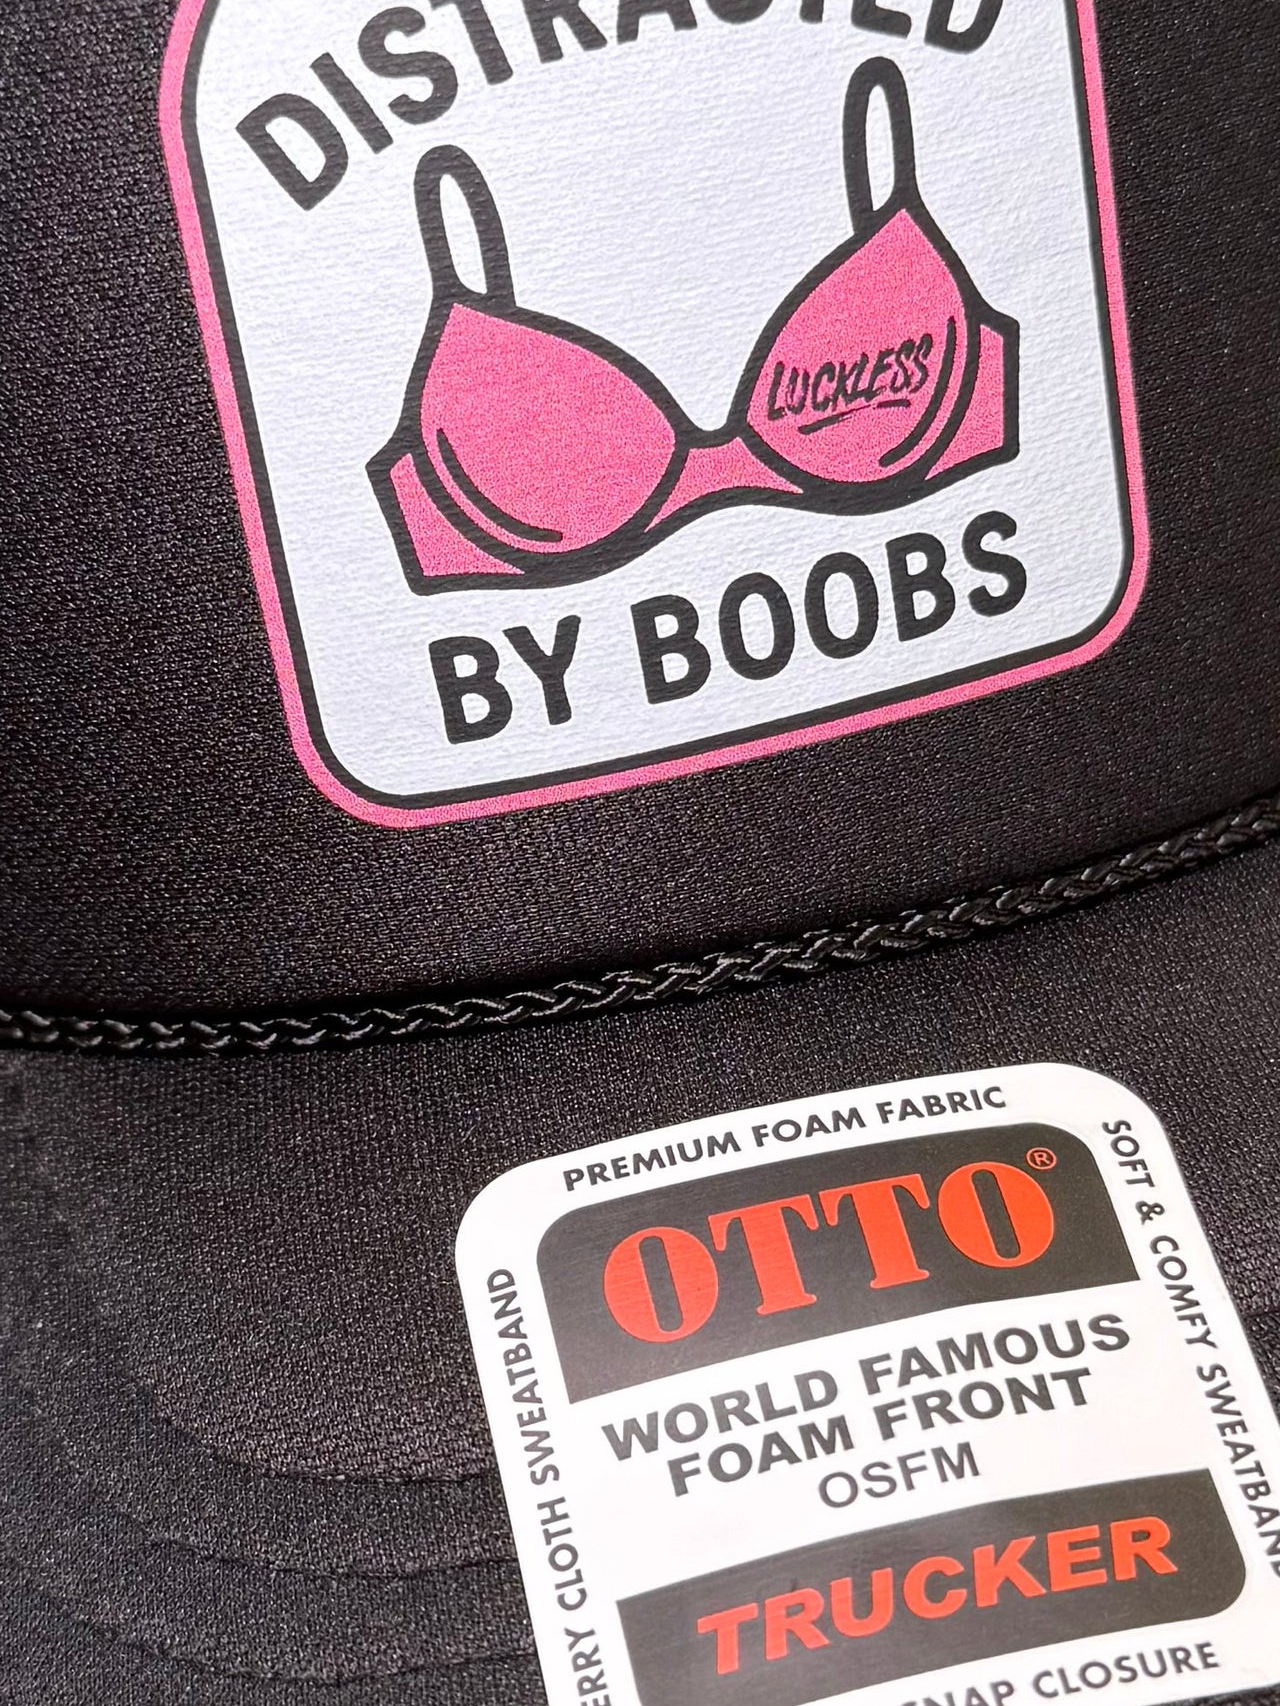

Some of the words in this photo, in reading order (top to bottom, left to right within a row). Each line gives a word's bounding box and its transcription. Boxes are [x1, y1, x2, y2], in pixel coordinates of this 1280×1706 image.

[766, 332, 934, 420] LUCKLESS
[428, 614, 581, 745] BY
[631, 509, 1028, 705] BOOBS
[562, 1131, 742, 1193] PREMIUM
[754, 1106, 867, 1149] FOAM
[875, 1085, 1008, 1126] FABRIC
[1101, 1118, 1155, 1191] SOFT
[1138, 1200, 1163, 1226] &
[1148, 1235, 1217, 1352] COMFY
[486, 1268, 563, 1484] SWEATBAND
[601, 1368, 839, 1463] WORLD
[862, 1313, 1131, 1397] FAMOUS
[667, 1415, 855, 1498] FOAM
[878, 1367, 1093, 1444] FRONT
[817, 1442, 982, 1510] OSFM
[537, 1495, 587, 1611] CLOTH
[696, 1515, 1178, 1676] TRUCKER
[1032, 1641, 1220, 1701] CLOSURE
